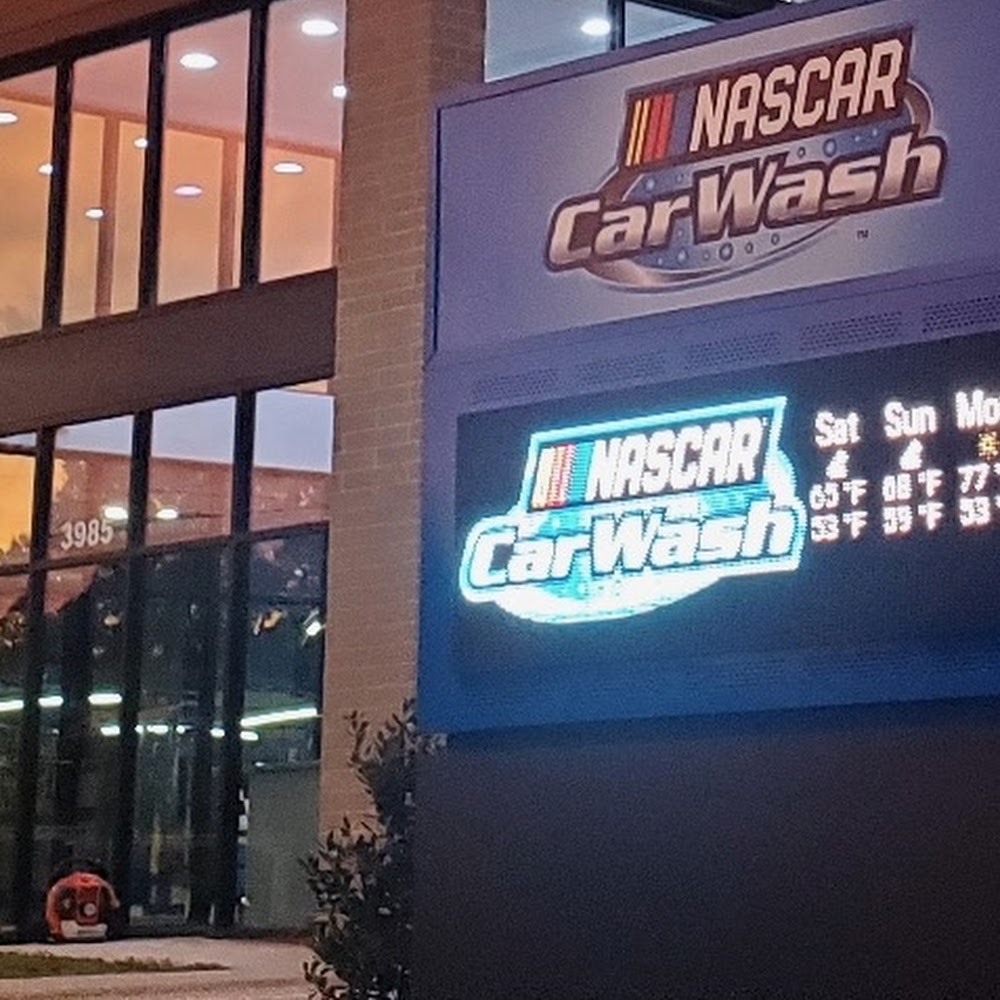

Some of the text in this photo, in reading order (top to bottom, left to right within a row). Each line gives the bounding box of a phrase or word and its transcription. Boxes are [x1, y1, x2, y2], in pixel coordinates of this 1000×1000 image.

[688, 38, 904, 153] NASCAR
[814, 410, 861, 448] Sat
[884, 401, 938, 439] Sun
[584, 416, 764, 502] NASCAR
[60, 518, 114, 551] 3985
